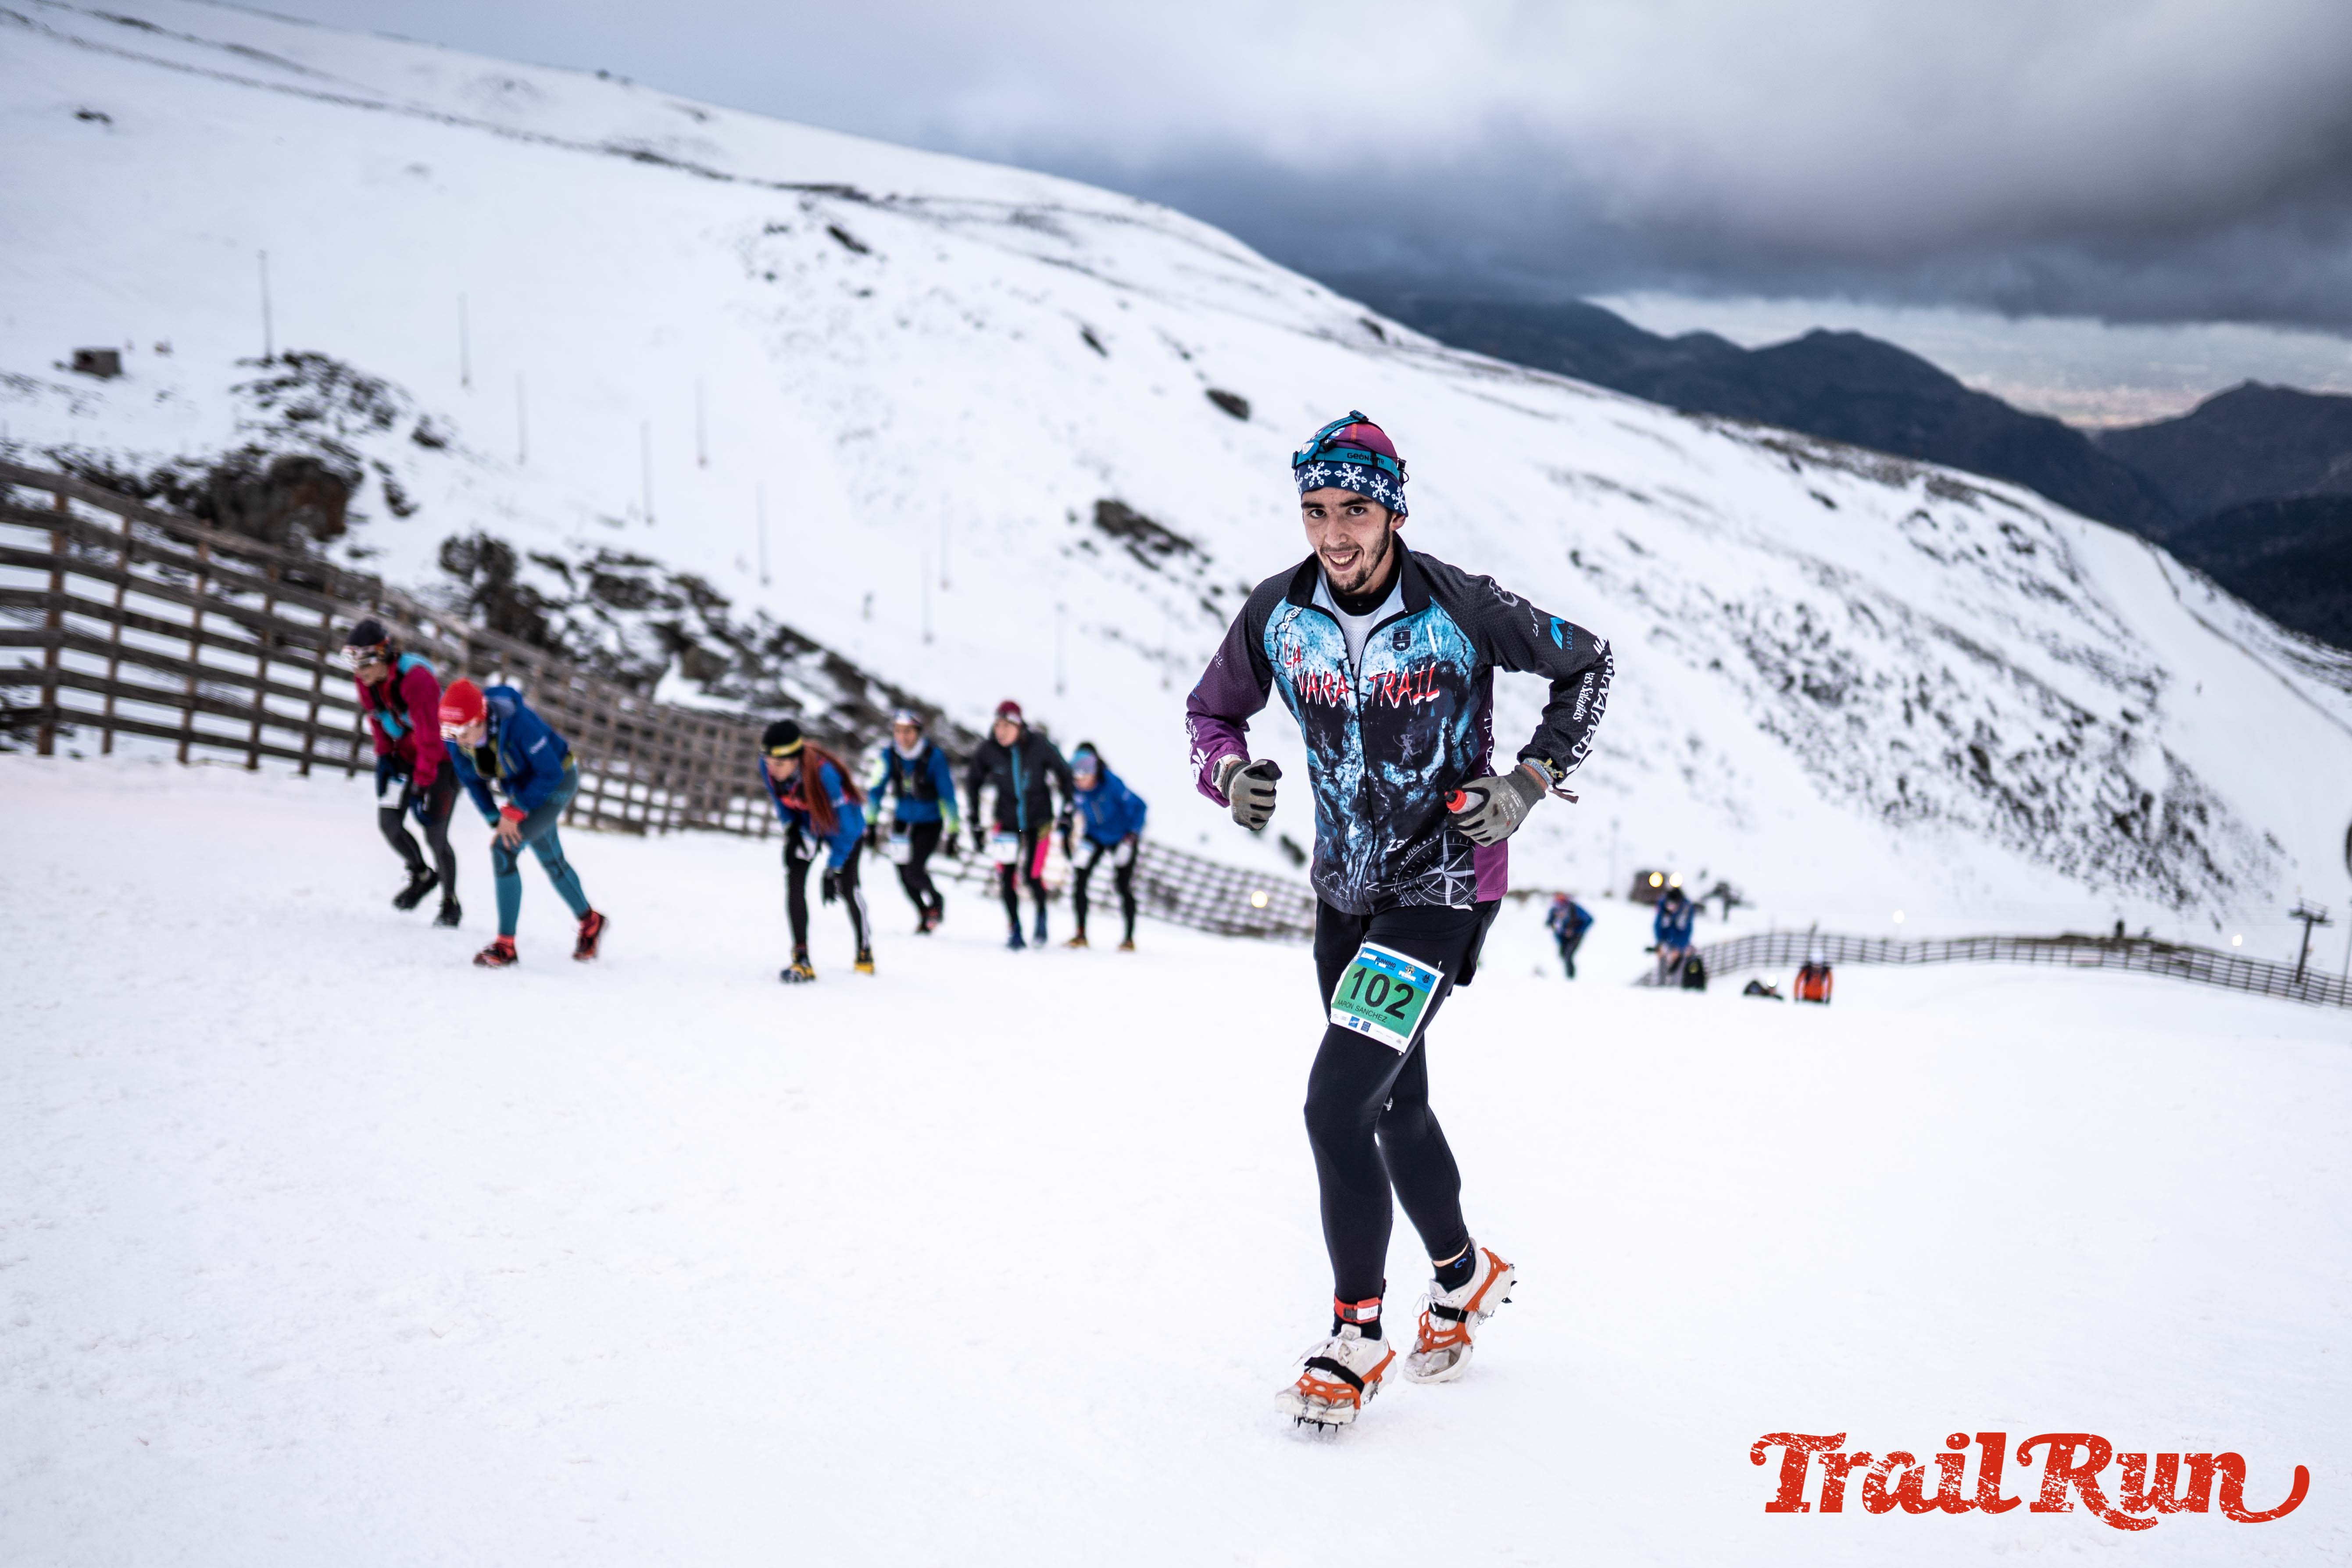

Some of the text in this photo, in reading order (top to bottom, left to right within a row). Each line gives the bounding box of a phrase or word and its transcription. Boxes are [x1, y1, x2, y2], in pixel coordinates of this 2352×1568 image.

[1283, 639, 1302, 672] LA
[1296, 662, 1440, 709] VARA TRAIL
[1337, 999, 1354, 1010] AARON
[1355, 1005, 1388, 1023] SANCHEZ
[1350, 967, 1414, 1020] 102
